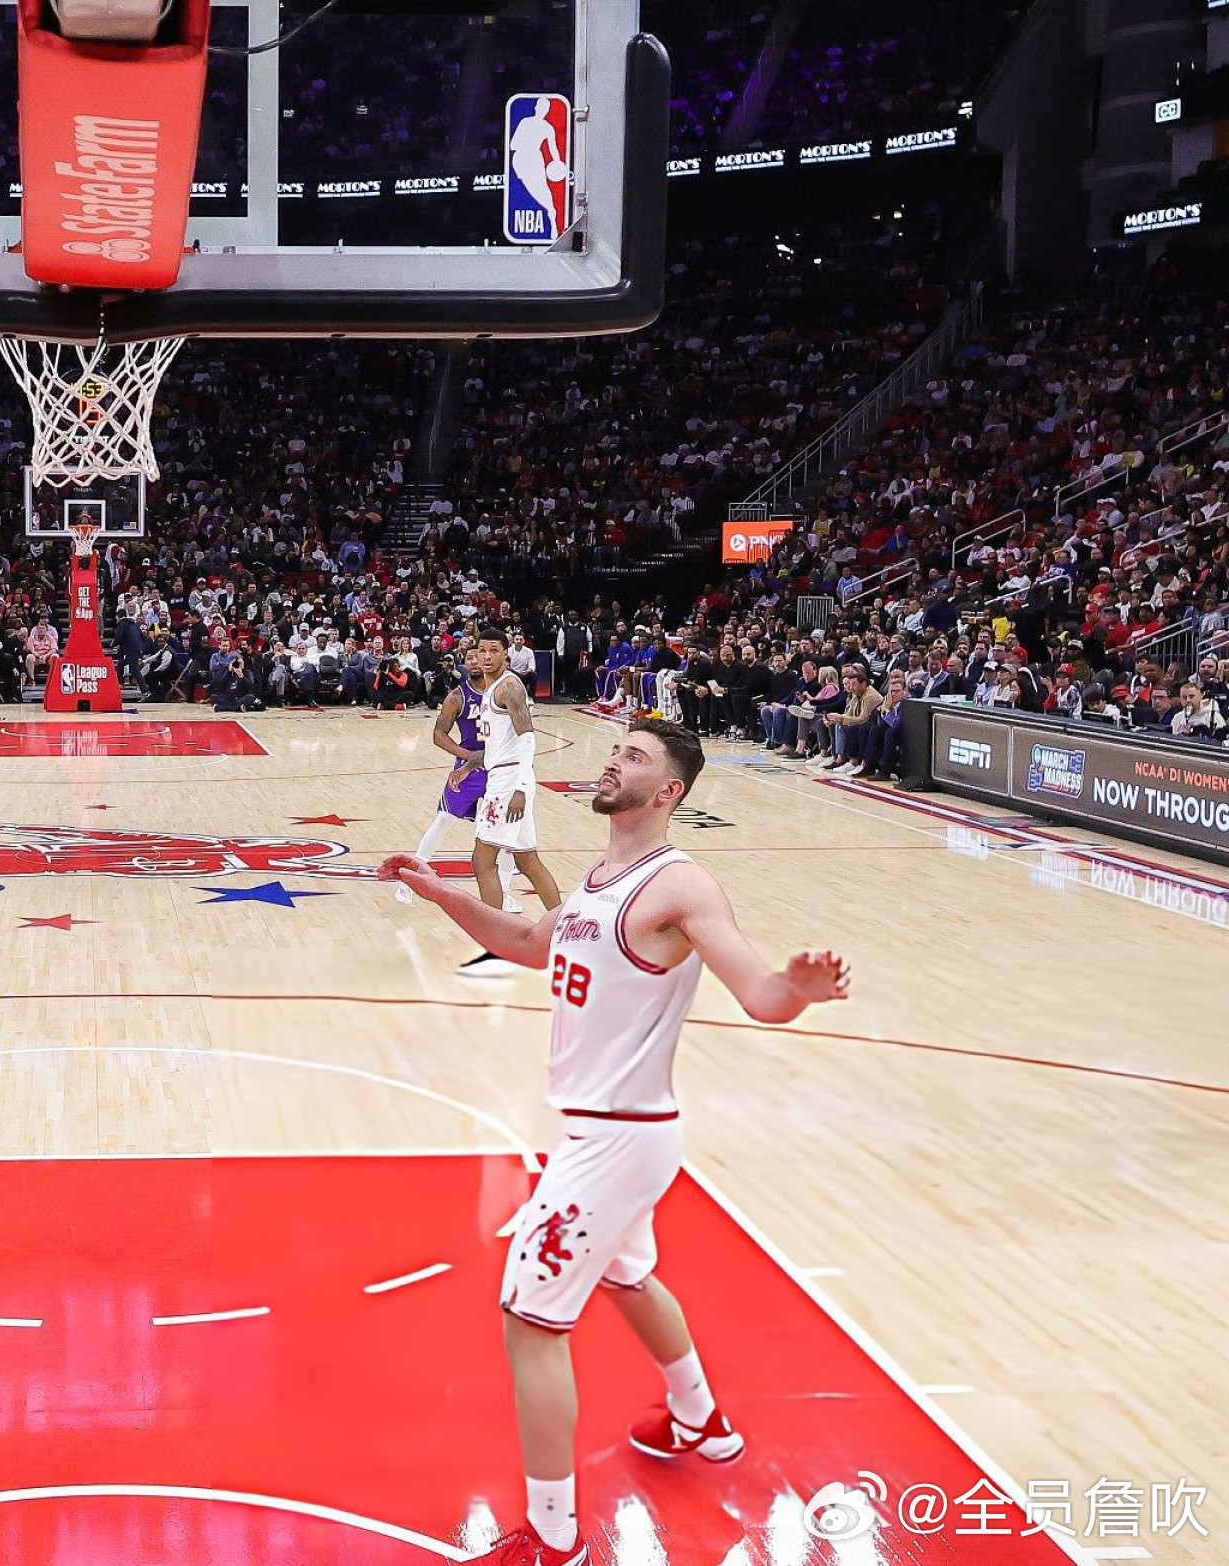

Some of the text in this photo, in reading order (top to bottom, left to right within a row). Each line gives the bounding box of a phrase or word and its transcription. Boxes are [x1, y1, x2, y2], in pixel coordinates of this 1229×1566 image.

[885, 127, 958, 148] MORTON'S
[799, 140, 873, 157] MORTON'S
[715, 150, 786, 167] MORTON'S
[317, 180, 382, 193] MORTON'S
[394, 176, 460, 189] MORTON'S
[514, 209, 545, 234] NBA
[1124, 203, 1203, 228] MORTON'S
[78, 586, 91, 597] GET
[78, 597, 91, 607] THE
[76, 663, 108, 680] League
[76, 680, 98, 693] Pass
[948, 737, 991, 769] ESPN
[1041, 750, 1069, 771] MARCH
[1044, 767, 1082, 792] MADNESS
[1093, 777, 1229, 832] NOW THROUG
[551, 953, 591, 1007] 28
